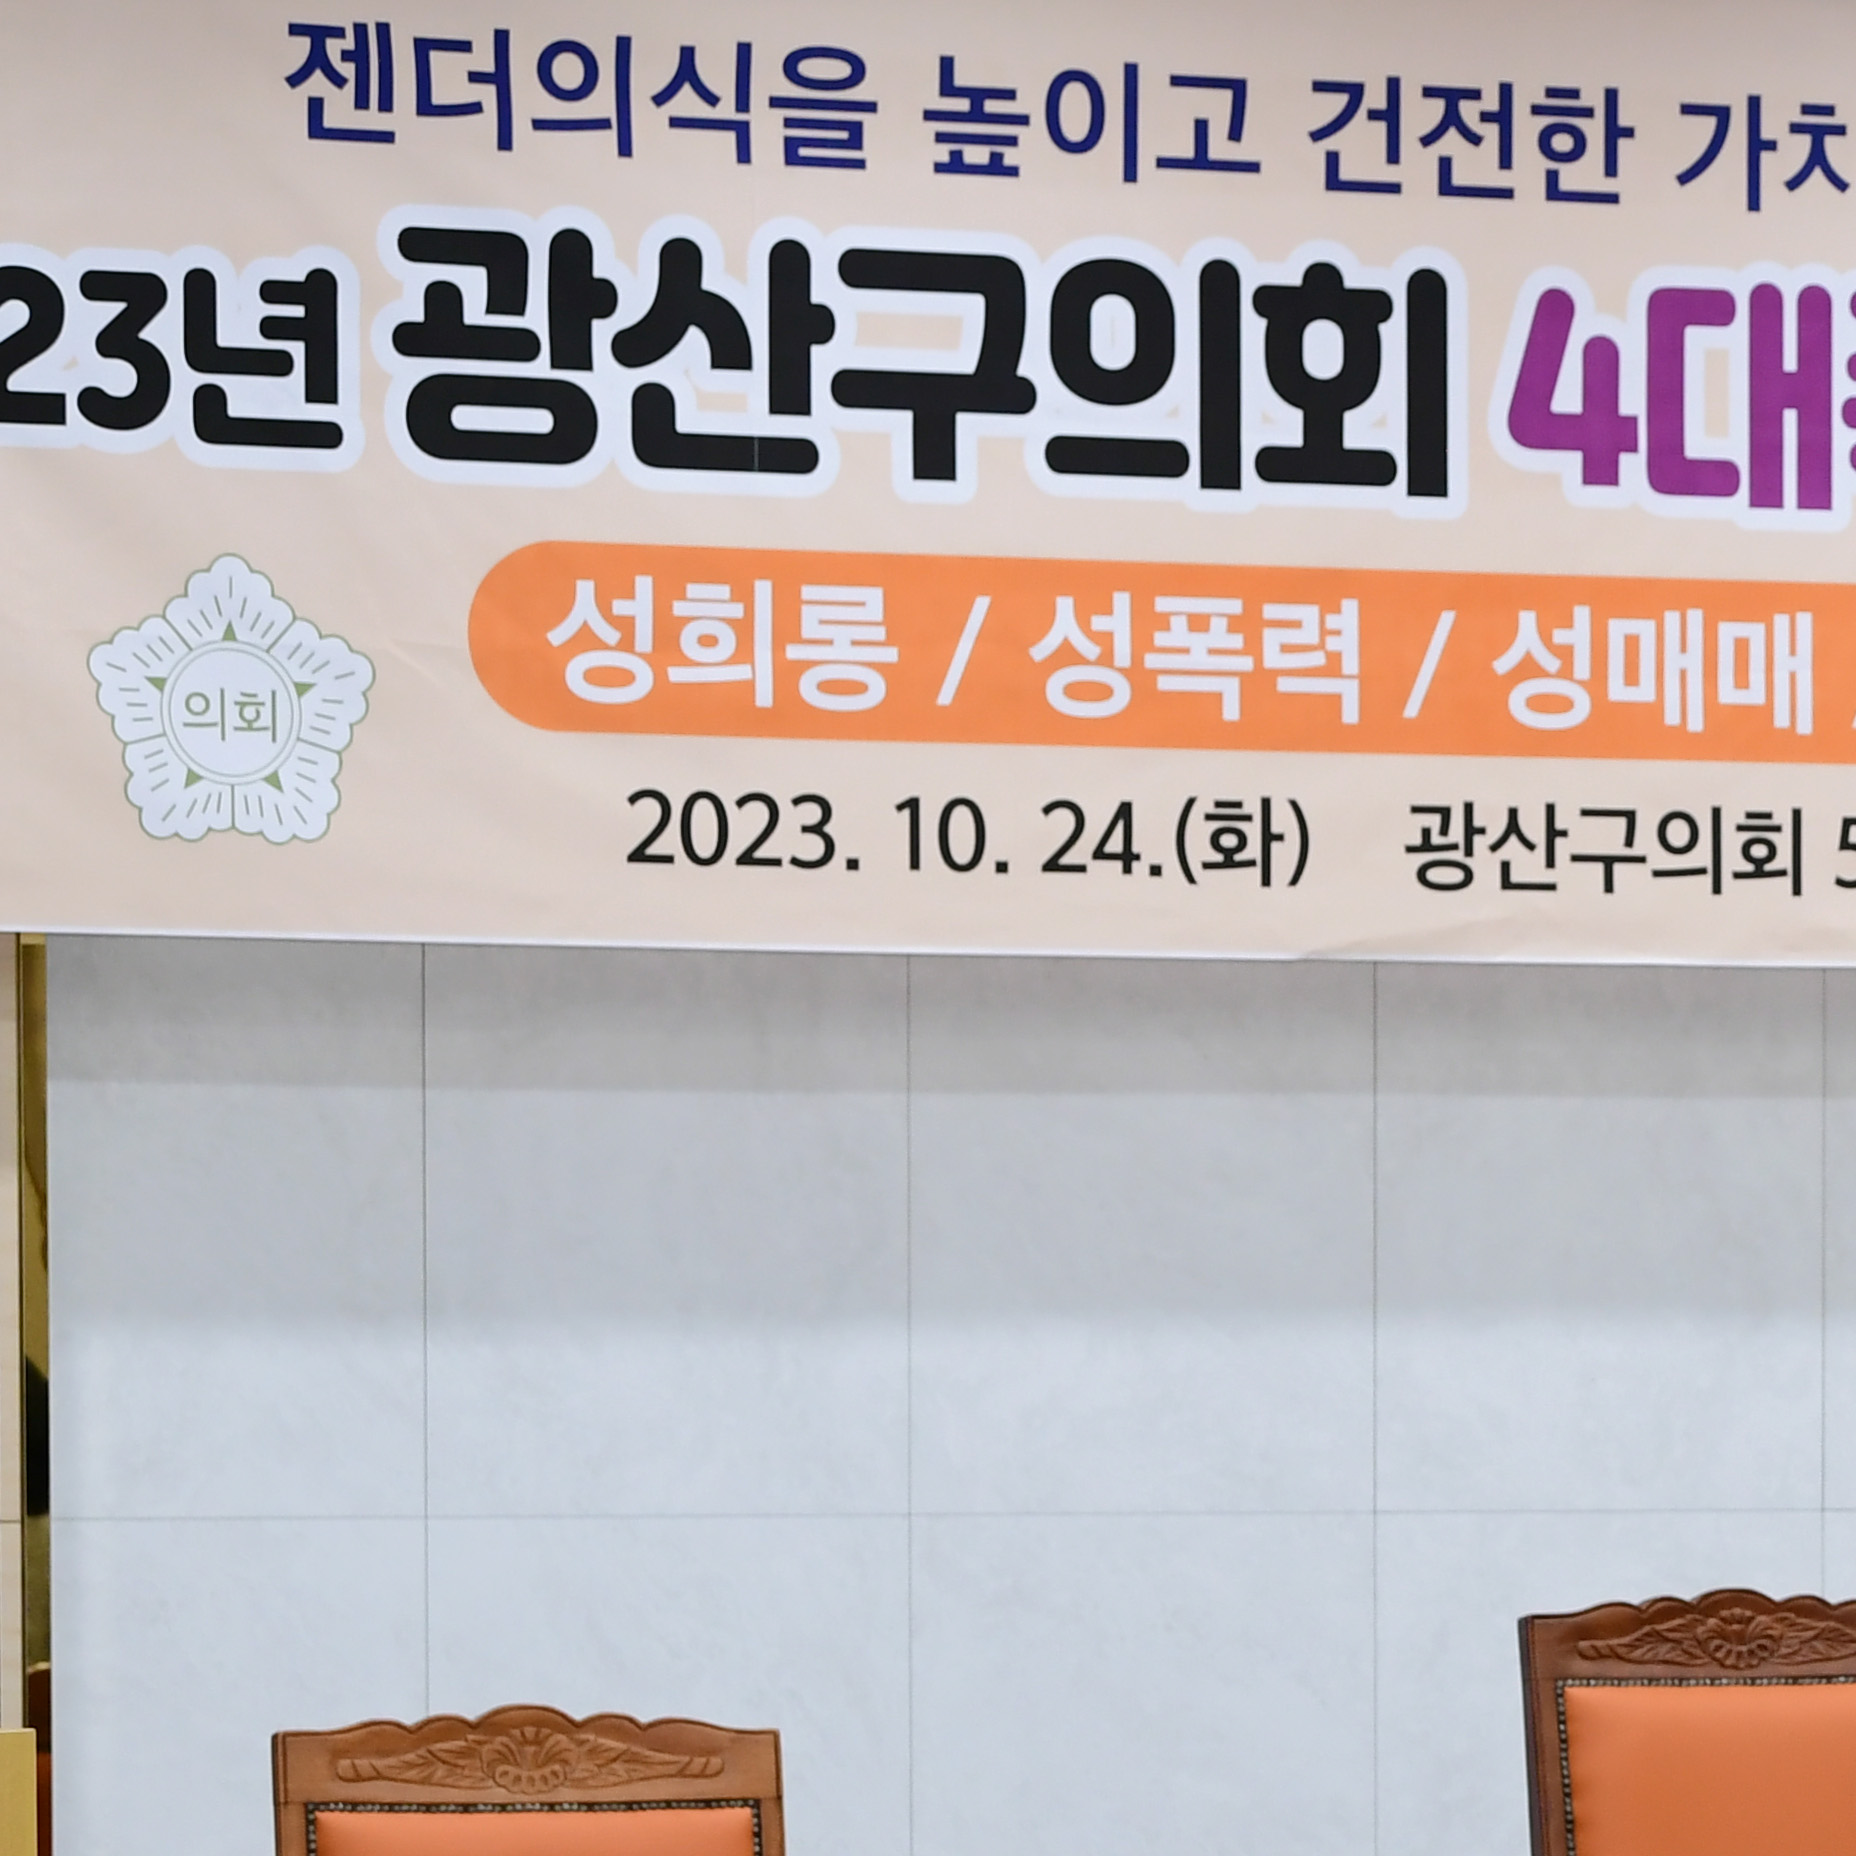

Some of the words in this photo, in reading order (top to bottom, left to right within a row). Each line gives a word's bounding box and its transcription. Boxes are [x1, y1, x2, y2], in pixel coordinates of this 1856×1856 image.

[285, 22, 877, 169] 젠더의식을
[923, 55, 1261, 183] 높이고
[1309, 76, 1635, 204] 건전한
[392, 227, 1448, 497] 광산구의회
[182, 687, 277, 743] 의회
[547, 575, 899, 712] 성희롱
[936, 596, 991, 706] /
[1029, 591, 1360, 724] 성폭력
[1403, 610, 1456, 718] /
[1493, 605, 1813, 735] 성매매
[627, 789, 859, 871] 2023.
[896, 797, 1008, 873] 10.
[1405, 802, 1801, 896] 광산구의회
